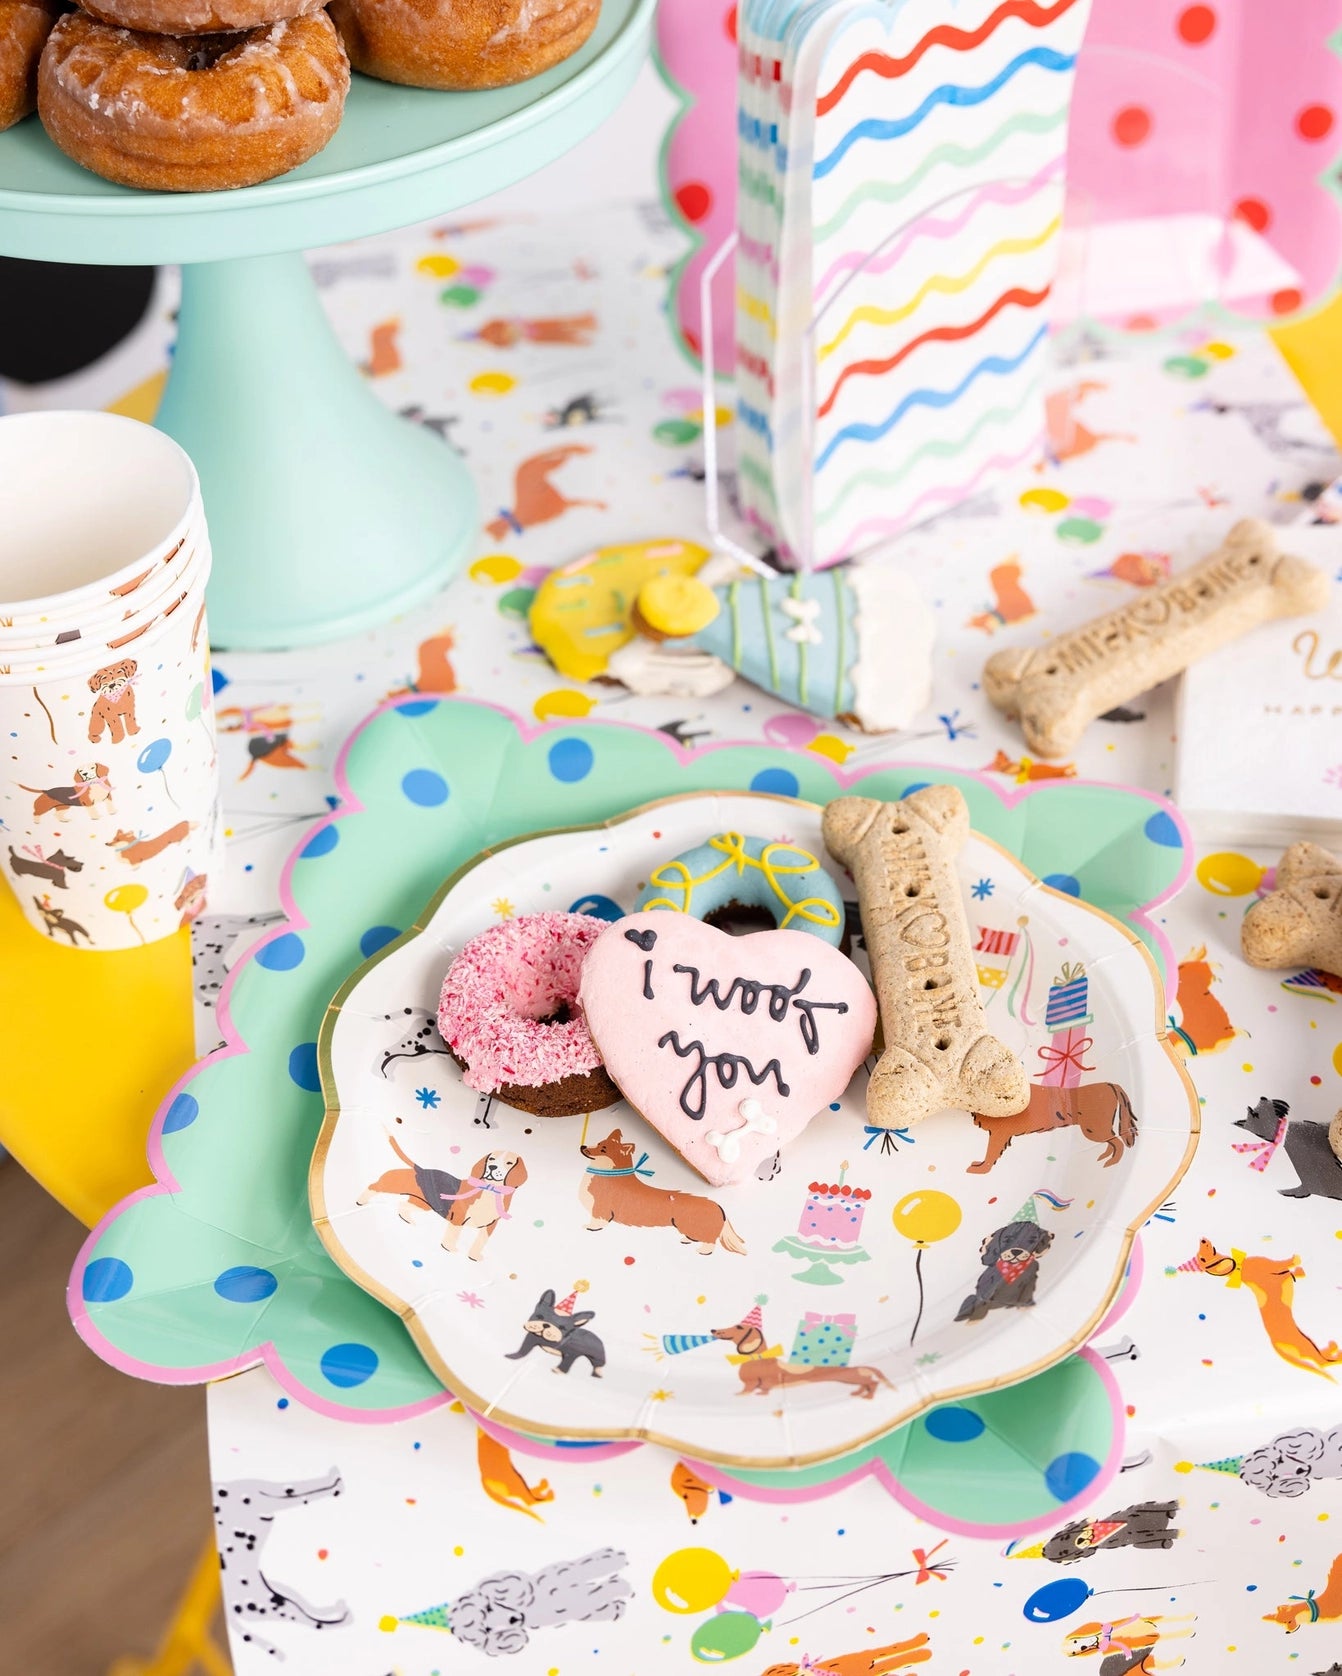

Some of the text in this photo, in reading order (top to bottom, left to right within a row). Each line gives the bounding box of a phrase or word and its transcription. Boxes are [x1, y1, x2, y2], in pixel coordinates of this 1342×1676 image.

[1167, 555, 1247, 615] BONE
[672, 967, 849, 1056] woof
[902, 949, 962, 1034] BONE
[657, 1030, 791, 1121] you
